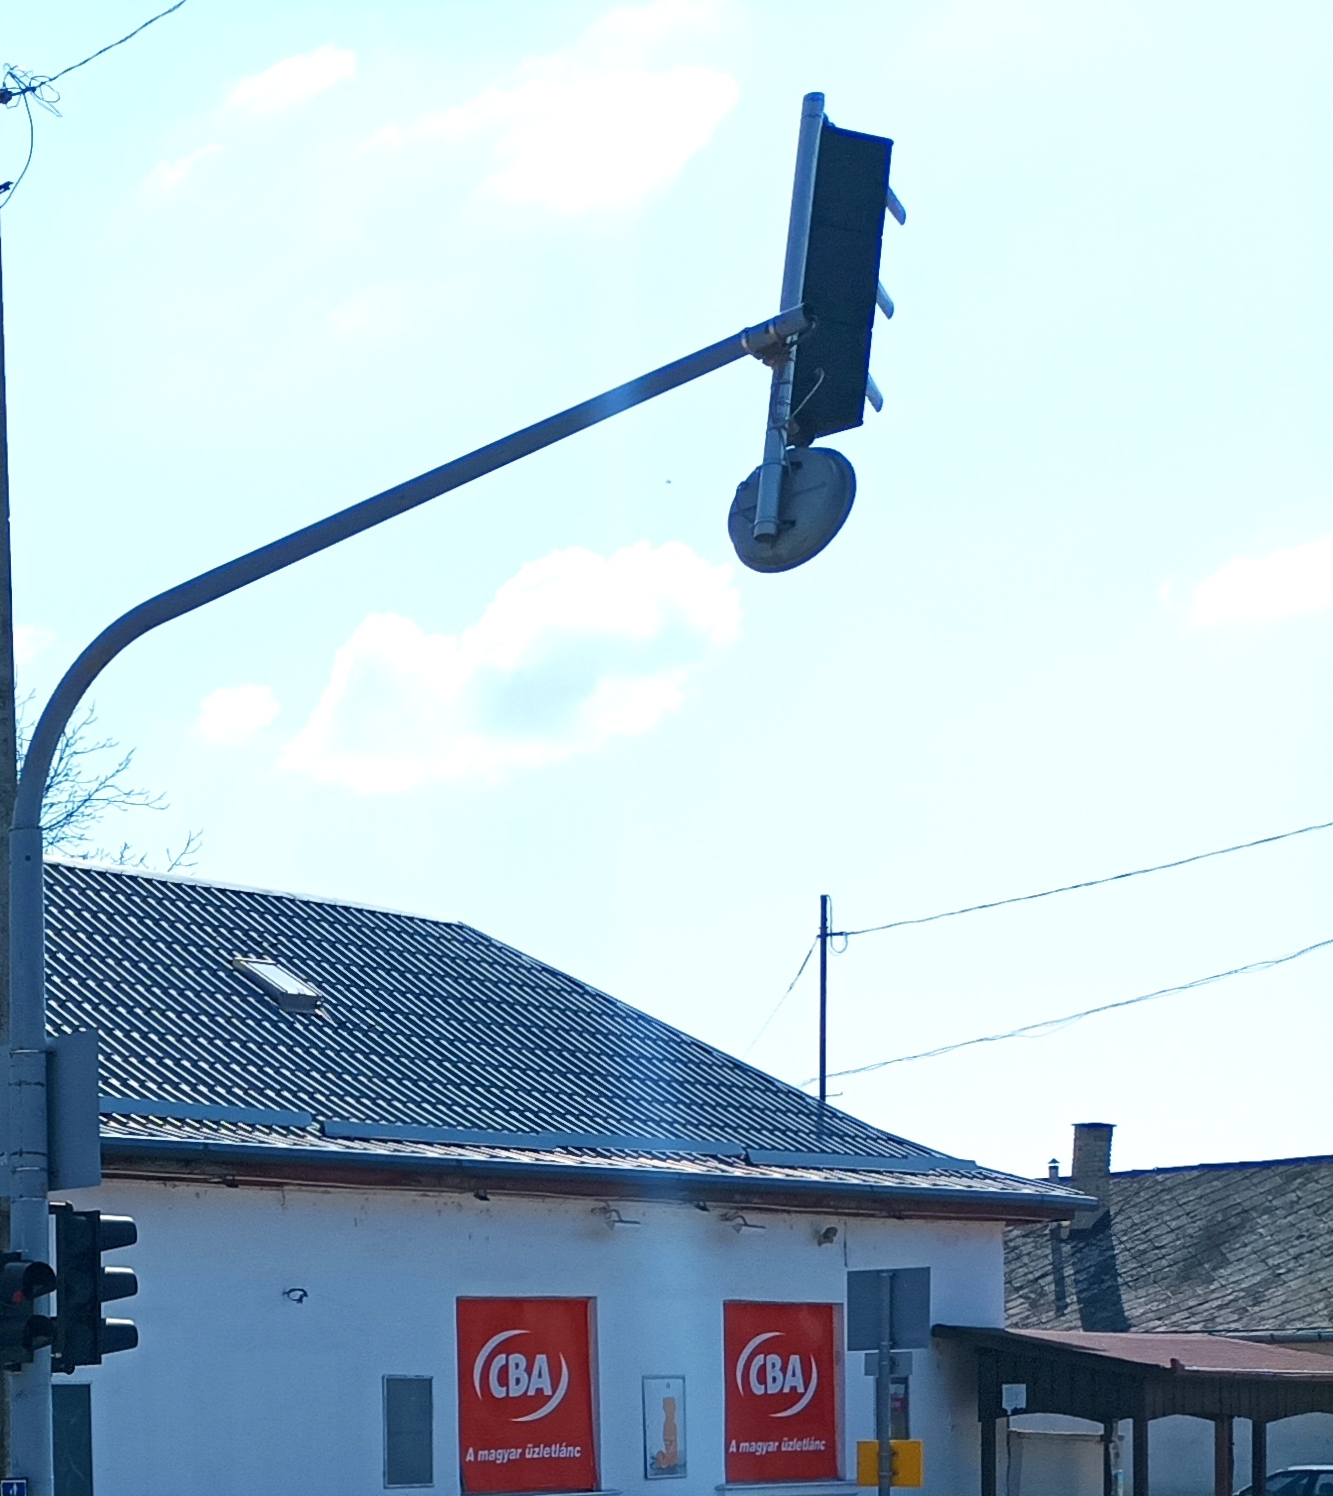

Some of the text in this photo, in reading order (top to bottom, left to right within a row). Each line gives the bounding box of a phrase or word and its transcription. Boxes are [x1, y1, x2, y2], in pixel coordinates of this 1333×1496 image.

[488, 1353, 553, 1399] CBA
[749, 1353, 805, 1396] CBA
[465, 1442, 582, 1464] A magyar üzletlánc
[729, 1439, 737, 1454] A
[739, 1441, 779, 1456] magyar
